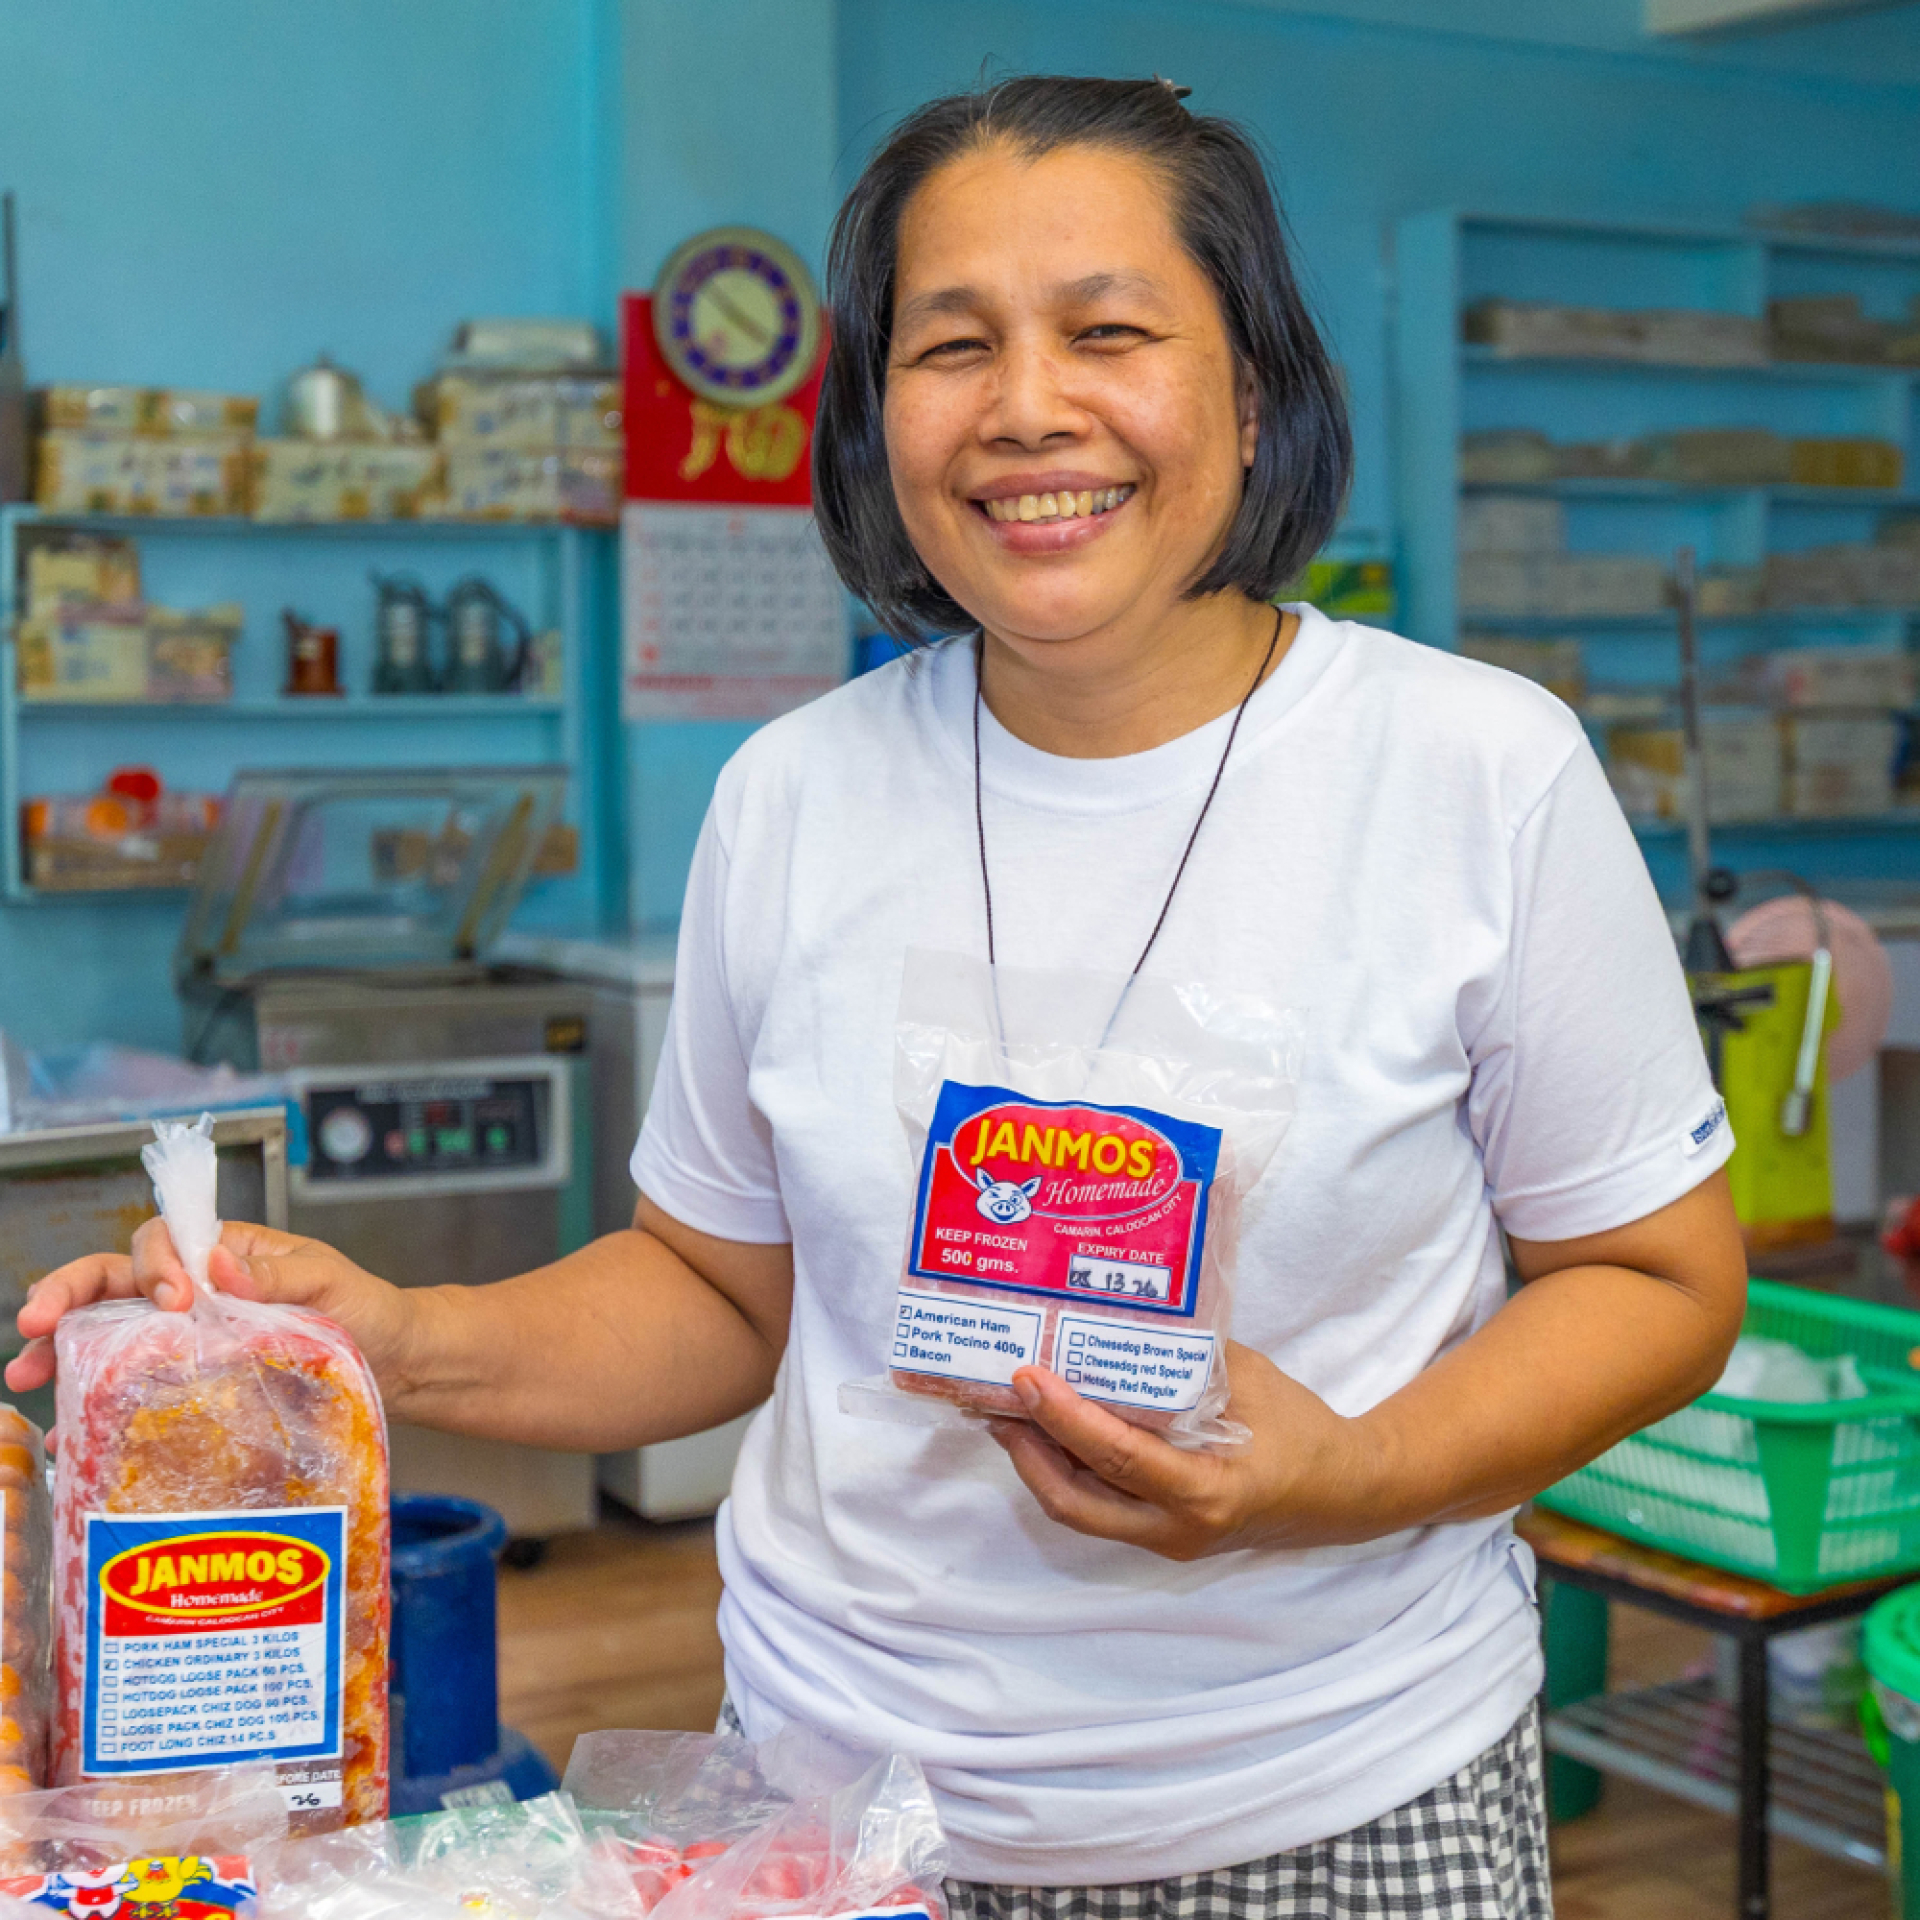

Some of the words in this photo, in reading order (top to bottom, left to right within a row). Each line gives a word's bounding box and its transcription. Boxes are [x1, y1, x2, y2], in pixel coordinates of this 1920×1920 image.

[968, 1118, 1155, 1178] JANMOS
[1042, 1175, 1166, 1206] Homemade
[1105, 1212, 1162, 1236] CALOOCAN
[1162, 1191, 1182, 1215] CITY
[935, 1227, 973, 1243] KEEP
[974, 1232, 1028, 1252] FROZEN
[941, 1248, 972, 1266] 500
[976, 1256, 1019, 1274] gms.
[1077, 1242, 1127, 1259] EXPIRY
[1129, 1250, 1165, 1265] DATE
[914, 1308, 976, 1328] American
[980, 1318, 1010, 1334] Ham
[909, 1345, 951, 1363] Bacon
[911, 1326, 942, 1342] Pork
[947, 1332, 991, 1350] Tocino
[994, 1340, 1025, 1358] 400g
[1088, 1334, 1141, 1356] Cheesedog
[1143, 1343, 1174, 1358] Brown
[1176, 1347, 1208, 1362] Special
[1084, 1354, 1137, 1375] Cheesedog
[1140, 1363, 1156, 1376] red
[1159, 1364, 1193, 1380] Special
[1083, 1373, 1116, 1393] Hotdog
[1119, 1378, 1139, 1393] Red
[1140, 1381, 1178, 1398] Regular
[129, 1548, 304, 1596] JANMOS
[170, 1587, 263, 1608] Homemade
[124, 1641, 160, 1652] PORK
[163, 1639, 193, 1650] HAM
[196, 1636, 247, 1649] SPECIAL
[252, 1634, 259, 1645] 3
[263, 1631, 299, 1644] KILOS
[124, 1656, 180, 1669] CHICKEN
[184, 1652, 249, 1666] ORDINARY
[264, 1647, 300, 1660] KILOS
[123, 1673, 177, 1686] HOTDOG
[181, 1670, 221, 1683] LOOSE
[225, 1667, 258, 1679] PACK
[123, 1689, 176, 1703] HOTDOG
[180, 1685, 221, 1699] LOOSE
[225, 1683, 258, 1694] PACK
[201, 1702, 231, 1713] CHIZ
[235, 1699, 261, 1711] DOG
[121, 1723, 163, 1736] LOOSE
[167, 1721, 200, 1732] PACK
[205, 1718, 233, 1730] CHIZ
[238, 1714, 265, 1727] DOG
[121, 1741, 155, 1753] FOOT
[159, 1737, 193, 1749] LONG
[197, 1735, 226, 1746] CHIZ
